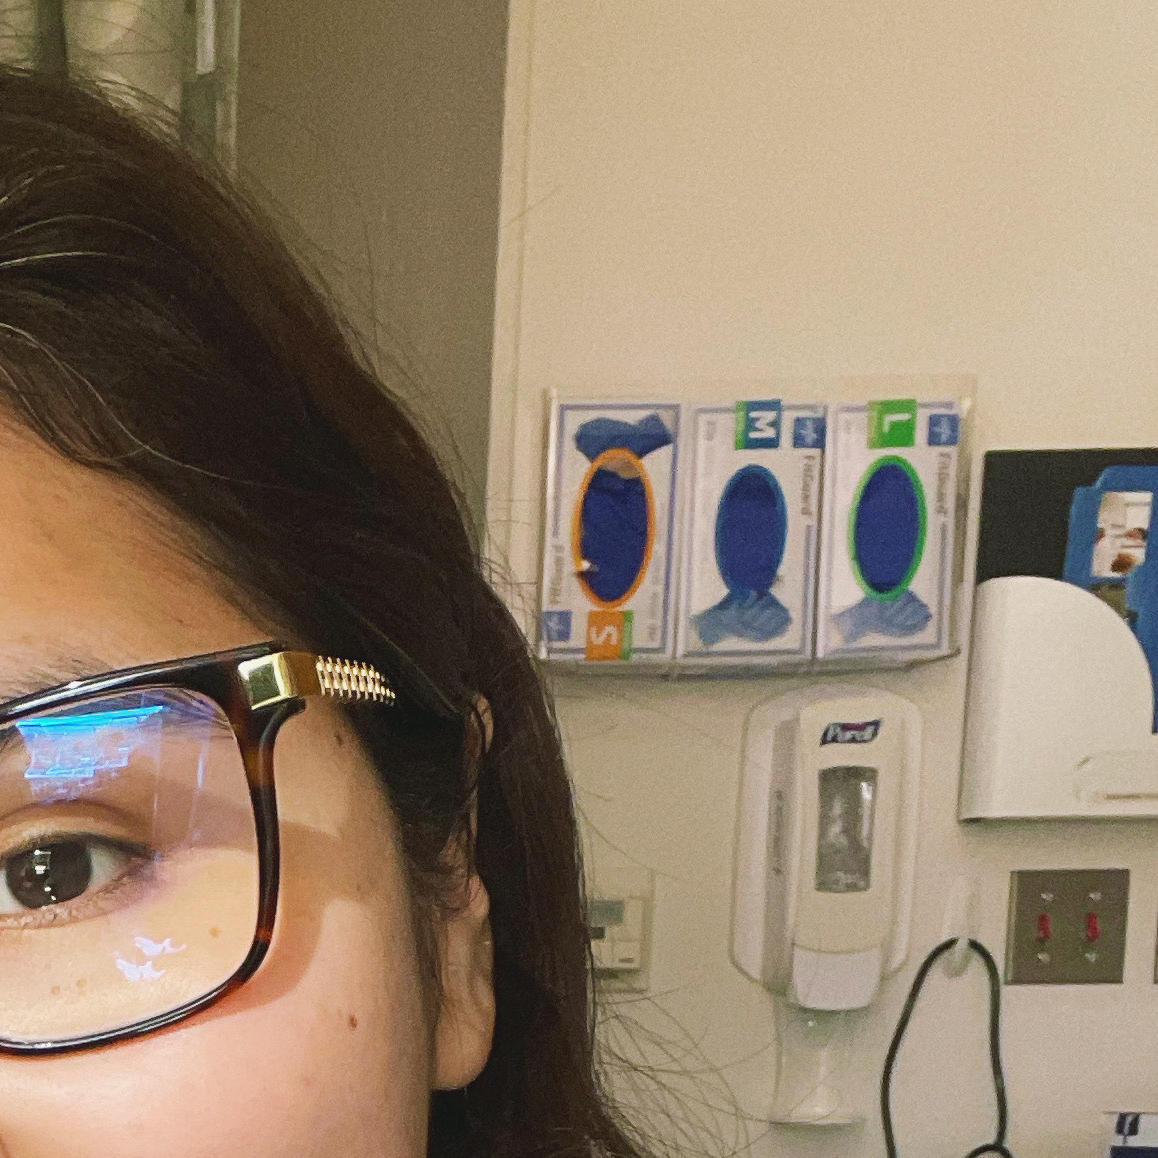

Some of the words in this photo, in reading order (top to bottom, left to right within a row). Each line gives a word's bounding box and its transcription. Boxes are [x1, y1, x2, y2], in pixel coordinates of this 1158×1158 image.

[747, 410, 777, 439] M
[882, 412, 912, 434] L
[589, 625, 619, 646] S
